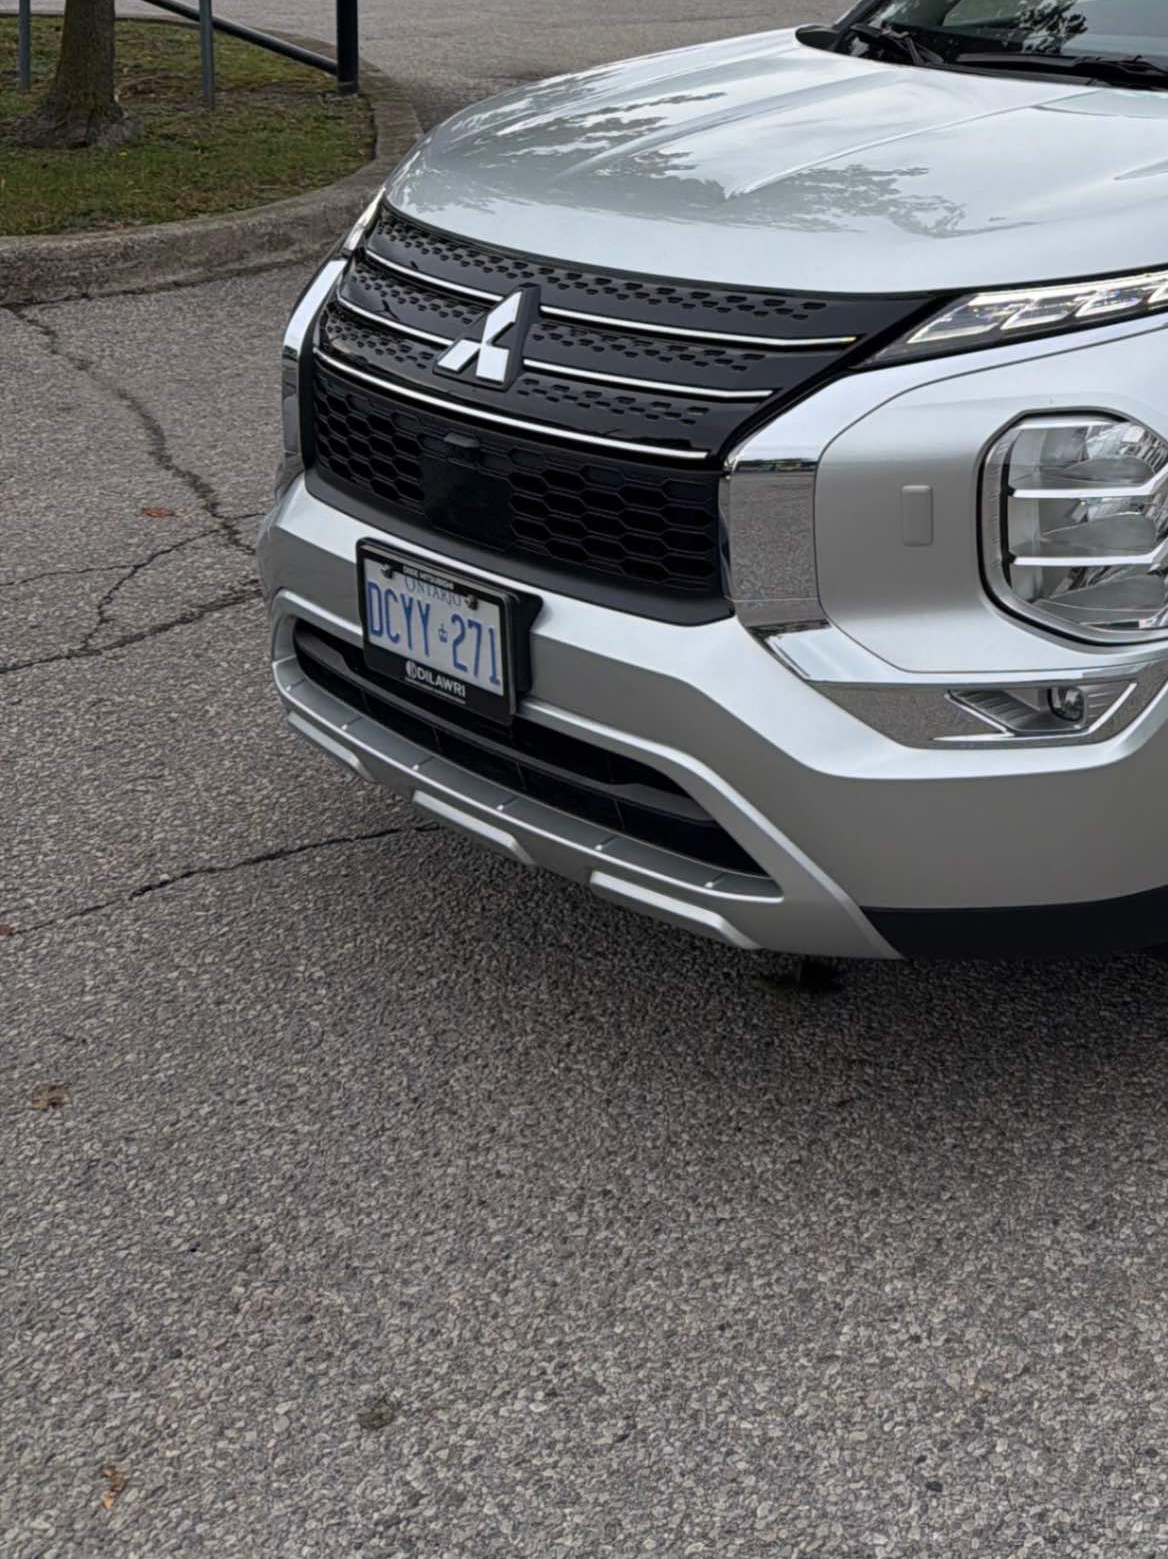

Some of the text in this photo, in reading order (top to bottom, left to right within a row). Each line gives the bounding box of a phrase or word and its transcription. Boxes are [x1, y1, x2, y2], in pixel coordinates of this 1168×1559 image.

[367, 581, 501, 686] DCYY 271
[416, 666, 466, 698] DILAWRI
